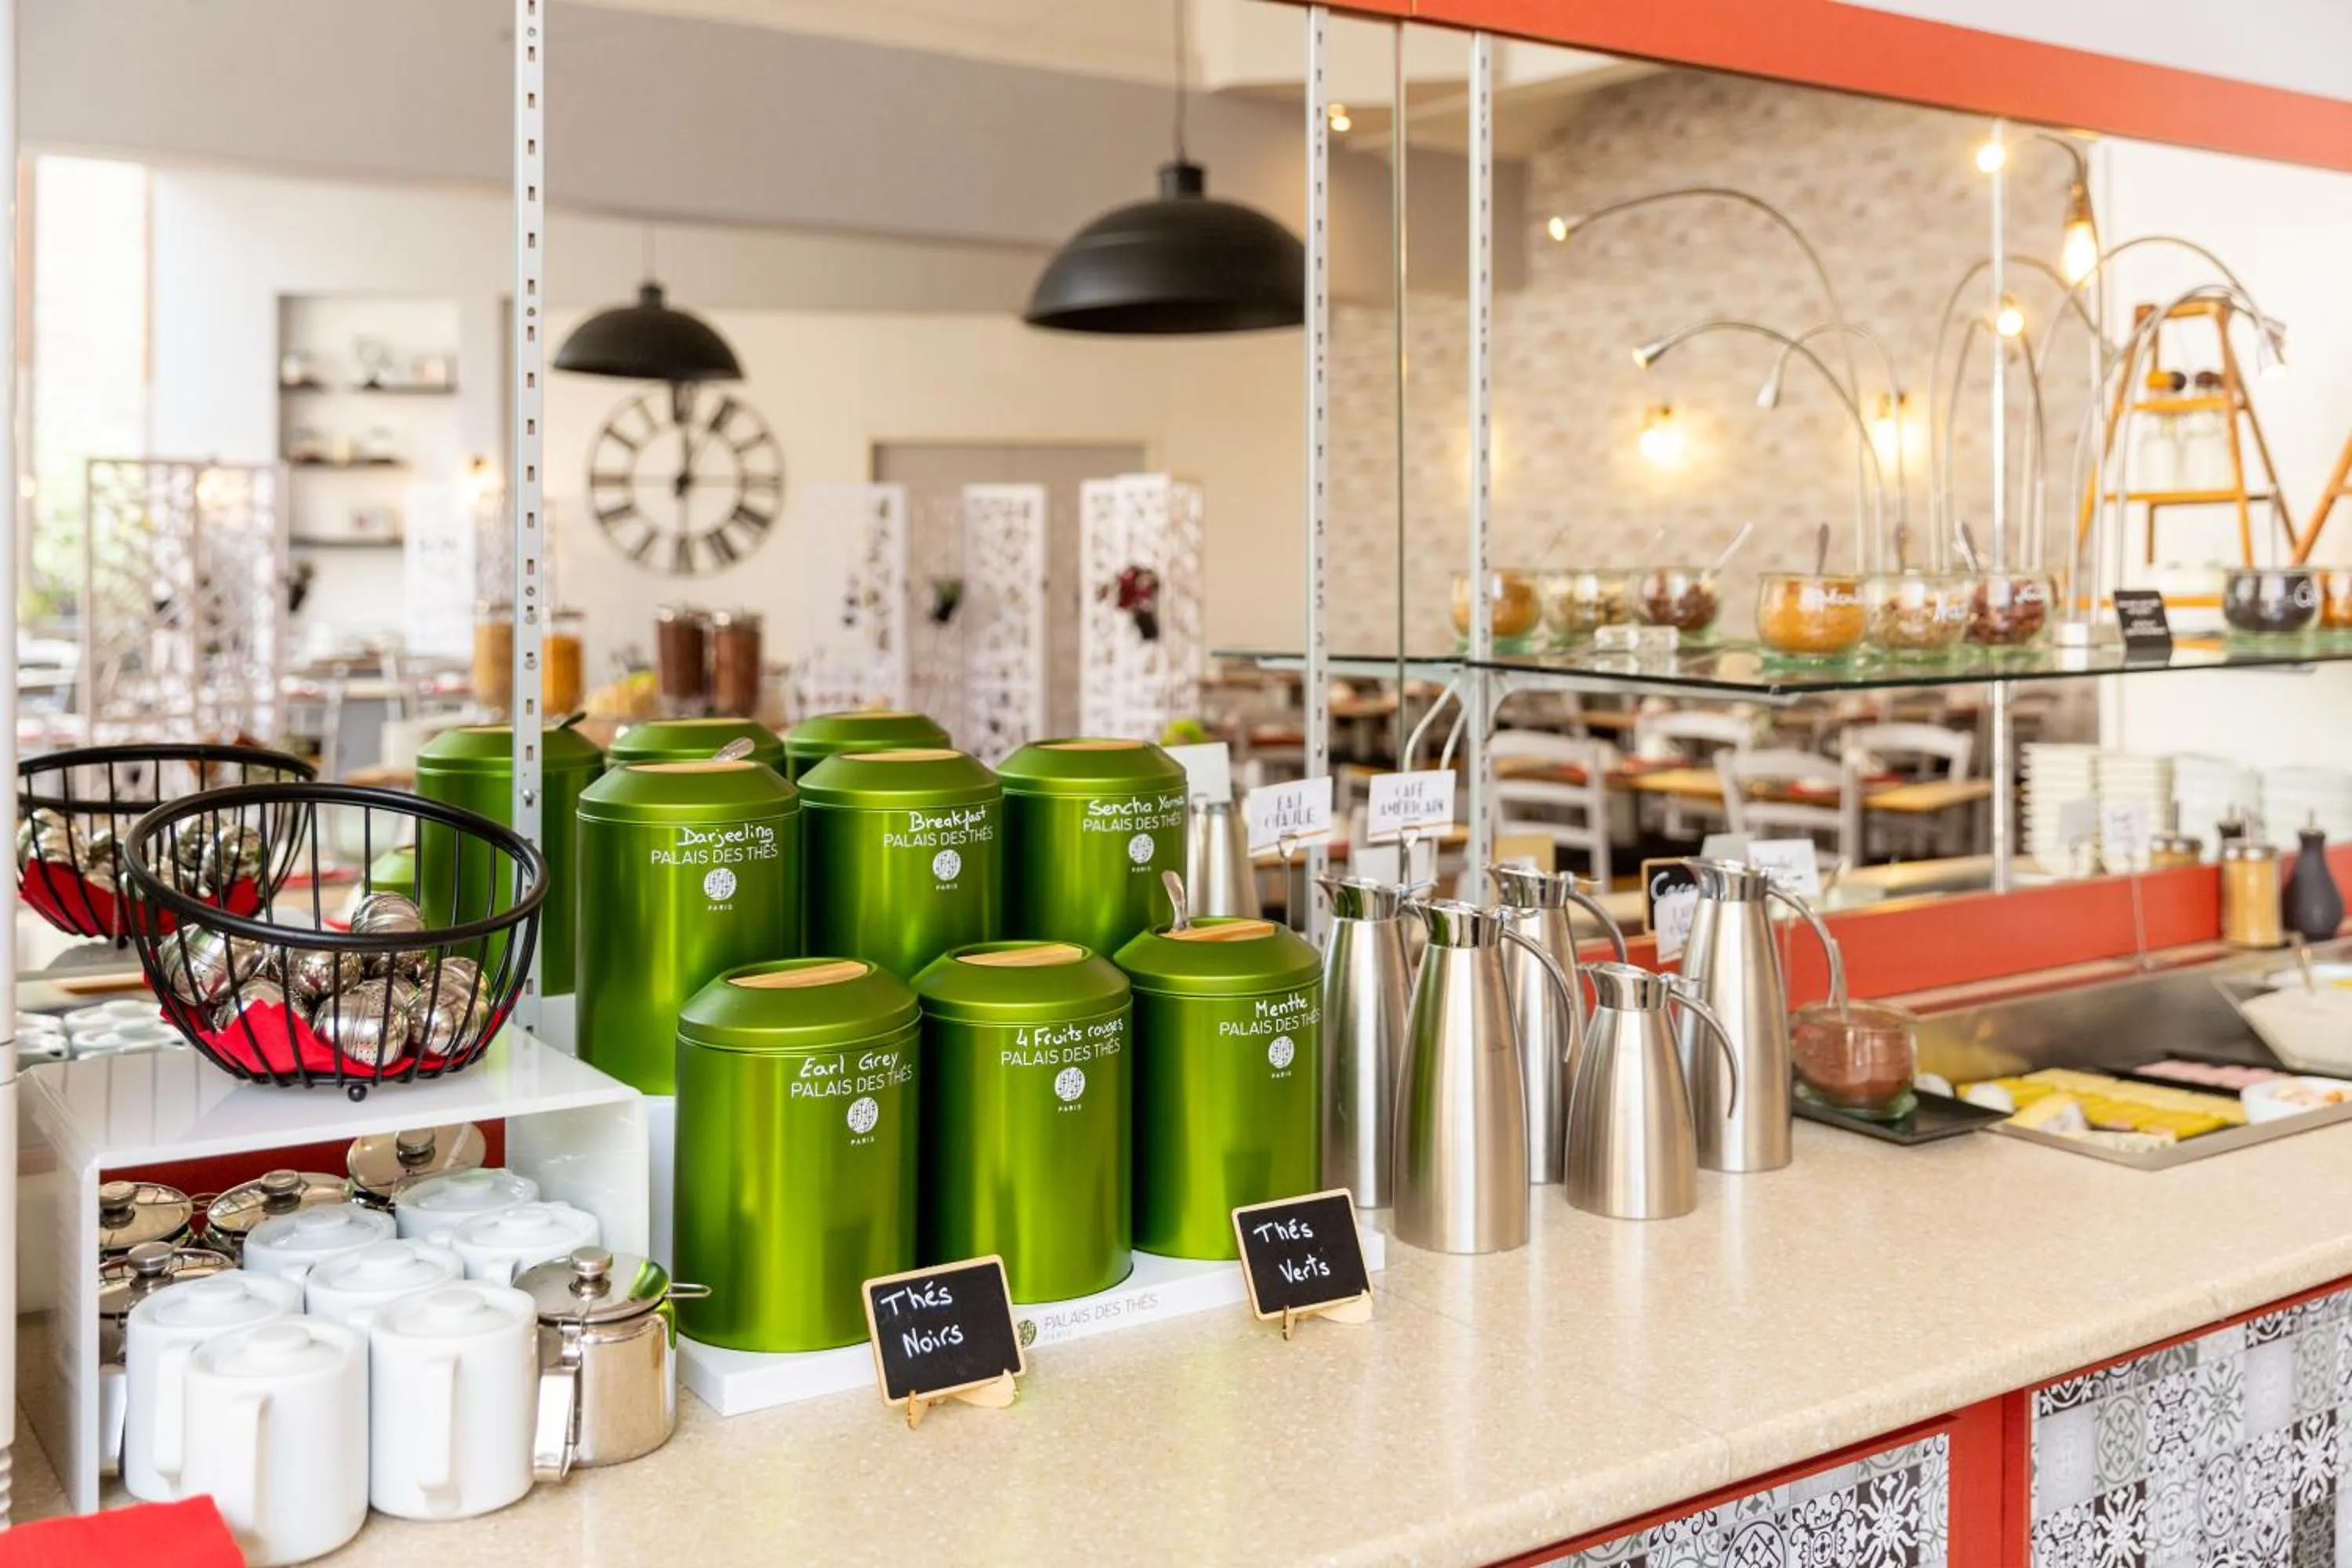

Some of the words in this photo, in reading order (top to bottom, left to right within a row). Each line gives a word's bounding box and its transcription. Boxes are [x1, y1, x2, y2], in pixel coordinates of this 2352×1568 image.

[909, 804, 987, 833] Breakfast
[1087, 796, 1152, 816] Sencha
[677, 822, 774, 848] Darjeeling
[1083, 818, 1133, 833] PALAIS
[1136, 816, 1159, 830] DES
[884, 832, 937, 848] PALAIS
[941, 829, 967, 846] DES
[651, 849, 710, 865] PALAIS
[713, 848, 743, 863] DES
[935, 883, 958, 891] PARIS
[1255, 992, 1308, 1018] Menthe
[1016, 1028, 1029, 1047] 4
[1034, 1022, 1082, 1047] Fruits
[1087, 1018, 1123, 1039] rouges
[1218, 1020, 1272, 1036] PALAIS
[1276, 1015, 1299, 1033] DES
[800, 1053, 844, 1079] Earl
[858, 1051, 900, 1070] Grey
[1000, 1051, 1059, 1067] PALAIS
[1063, 1045, 1091, 1064] DES
[791, 1079, 852, 1098] PALAIS
[857, 1073, 885, 1093] DES
[1271, 1070, 1292, 1079] PARIS
[1058, 1104, 1082, 1112] PARIS
[851, 1137, 874, 1146] PARIS
[1253, 1218, 1314, 1243] Thés
[1279, 1254, 1331, 1284] Verts
[880, 1280, 954, 1316] Thés
[1044, 1308, 1091, 1330] PALAIS
[1094, 1301, 1121, 1321] DES
[902, 1323, 964, 1359] Noirs
